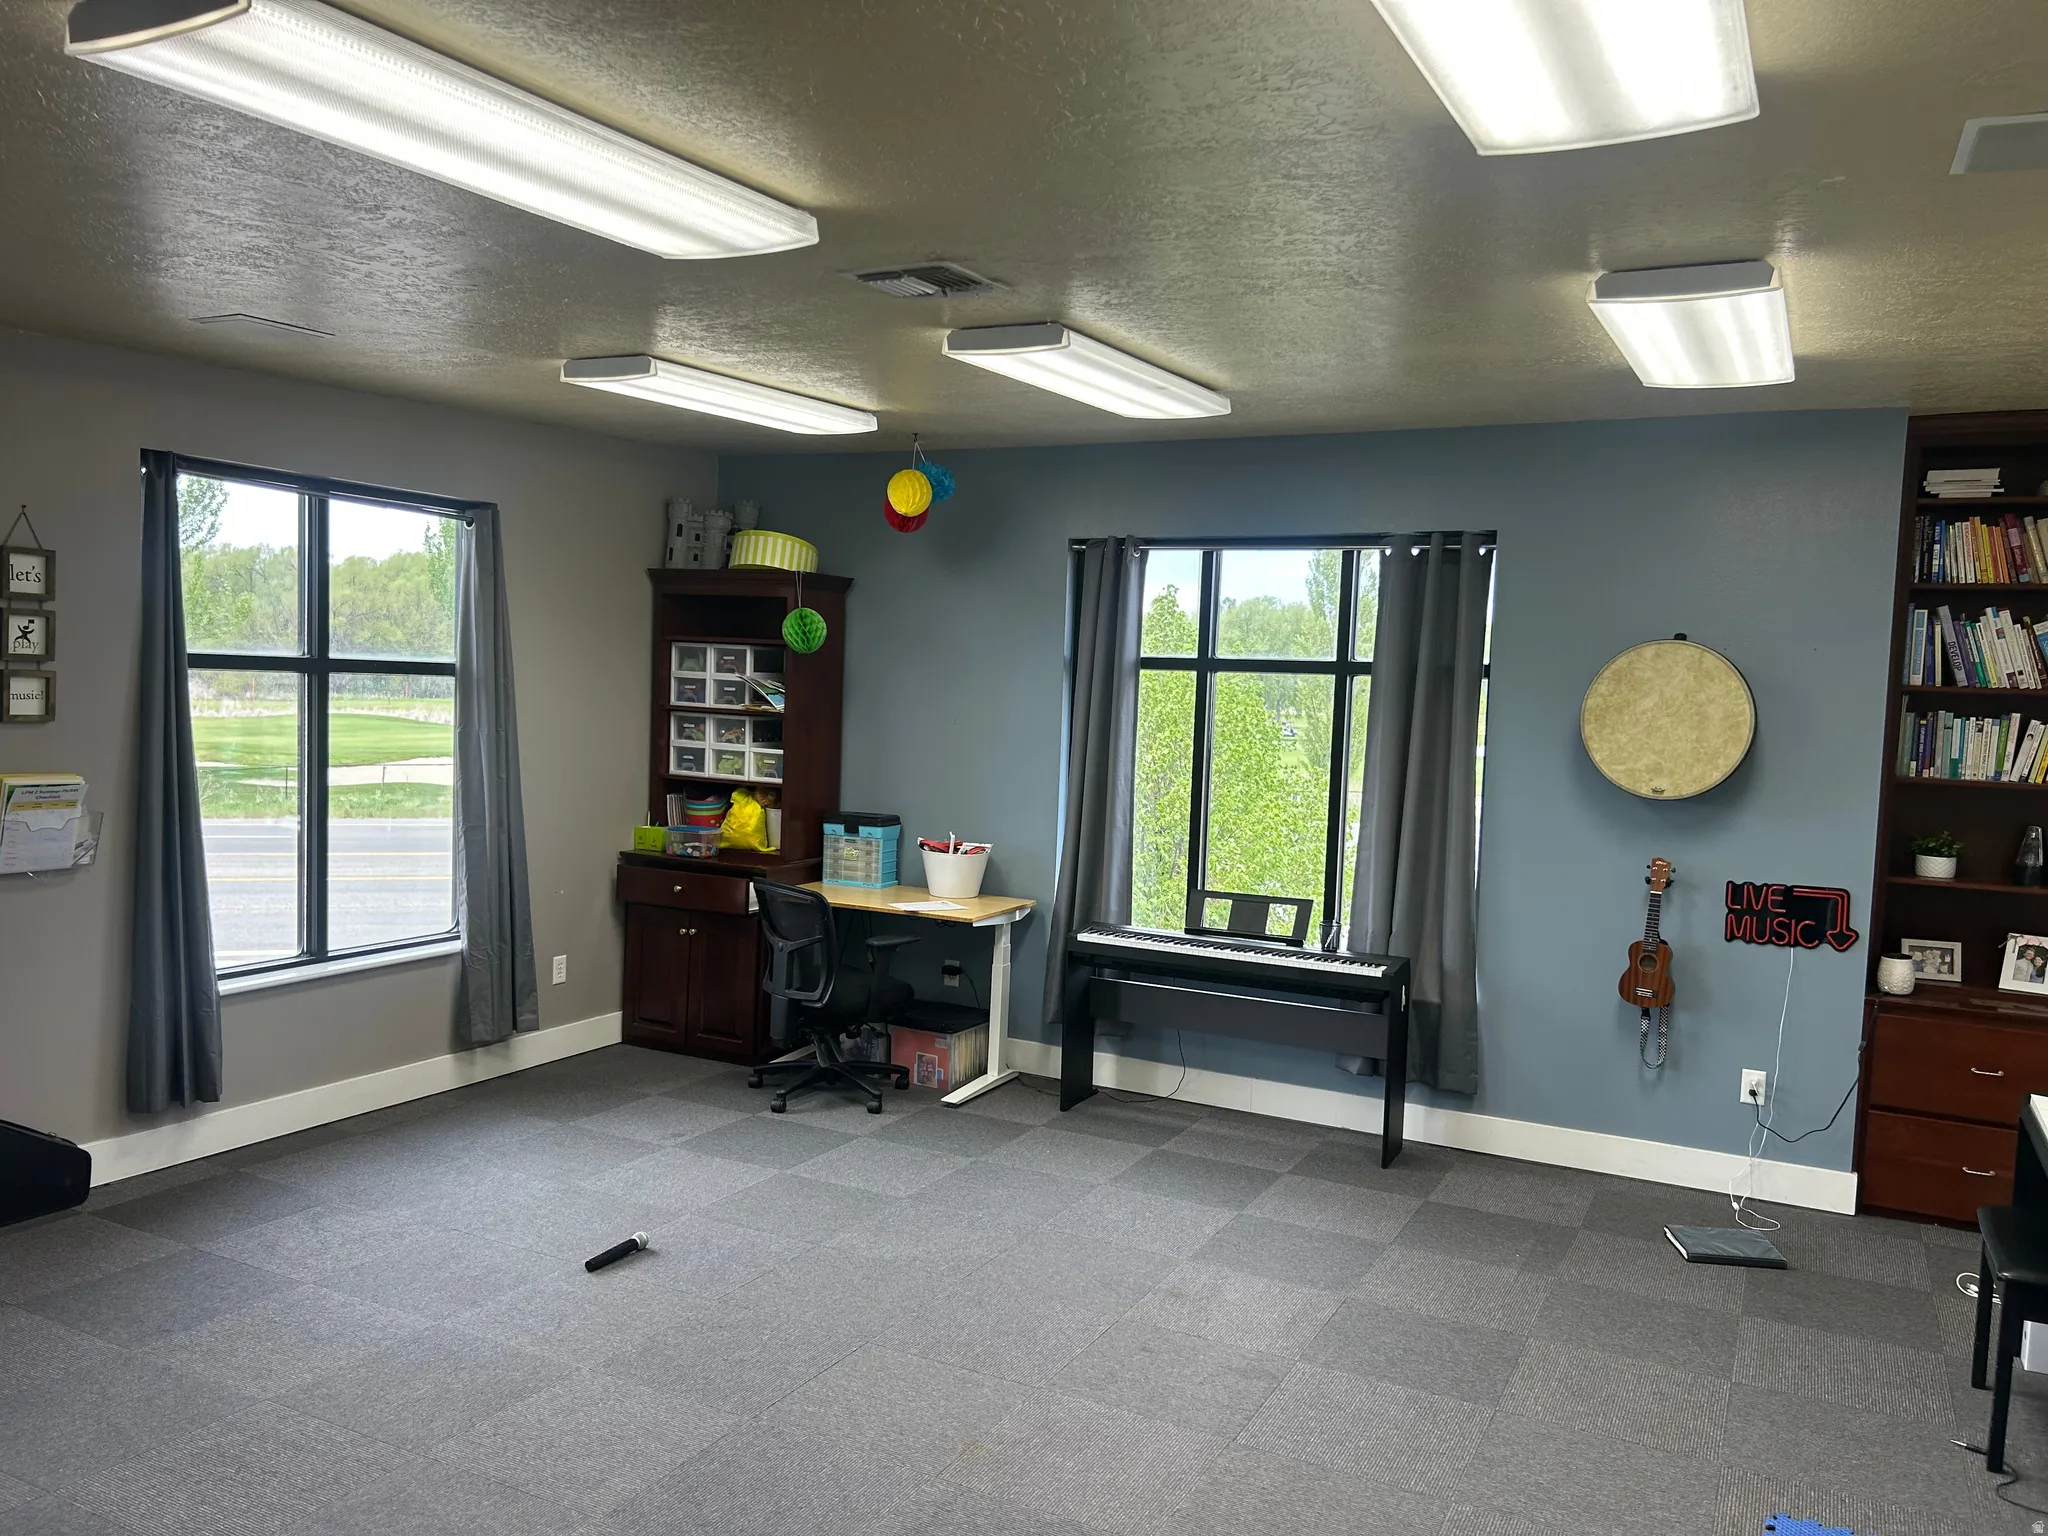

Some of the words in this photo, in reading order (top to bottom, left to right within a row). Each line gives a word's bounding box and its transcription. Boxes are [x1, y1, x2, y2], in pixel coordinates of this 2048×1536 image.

[10, 563, 42, 583] let's
[12, 636, 39, 653] play
[1947, 640, 1963, 672] DEVELOP
[10, 690, 44, 701] music!
[1727, 883, 1786, 912] LIVE
[1726, 913, 1819, 947] MUSIC
